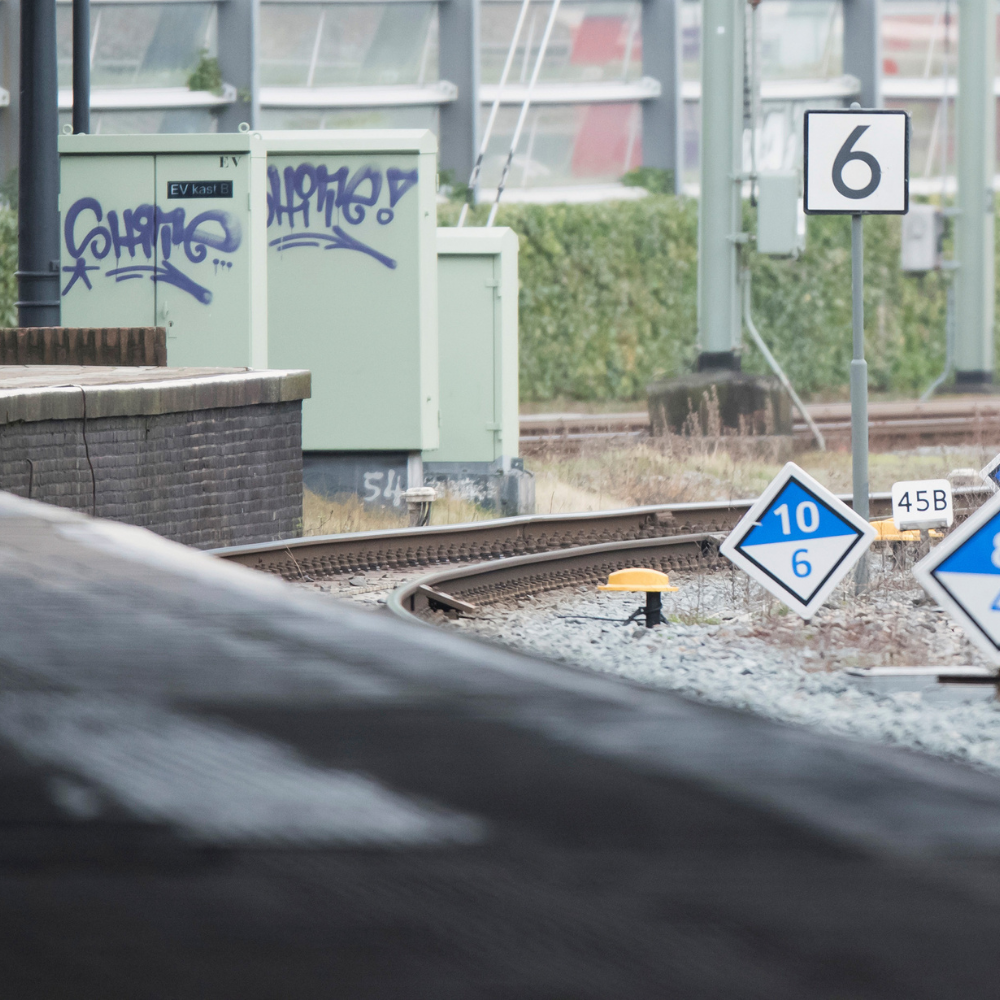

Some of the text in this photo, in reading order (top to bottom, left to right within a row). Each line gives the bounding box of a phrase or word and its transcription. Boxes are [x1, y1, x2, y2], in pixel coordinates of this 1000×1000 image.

[219, 156, 241, 168] EV
[831, 124, 882, 200] 6
[170, 183, 189, 195] EV
[192, 183, 217, 195] kast
[897, 488, 948, 513] 45B
[772, 500, 820, 536] 10
[791, 547, 813, 579] 6
